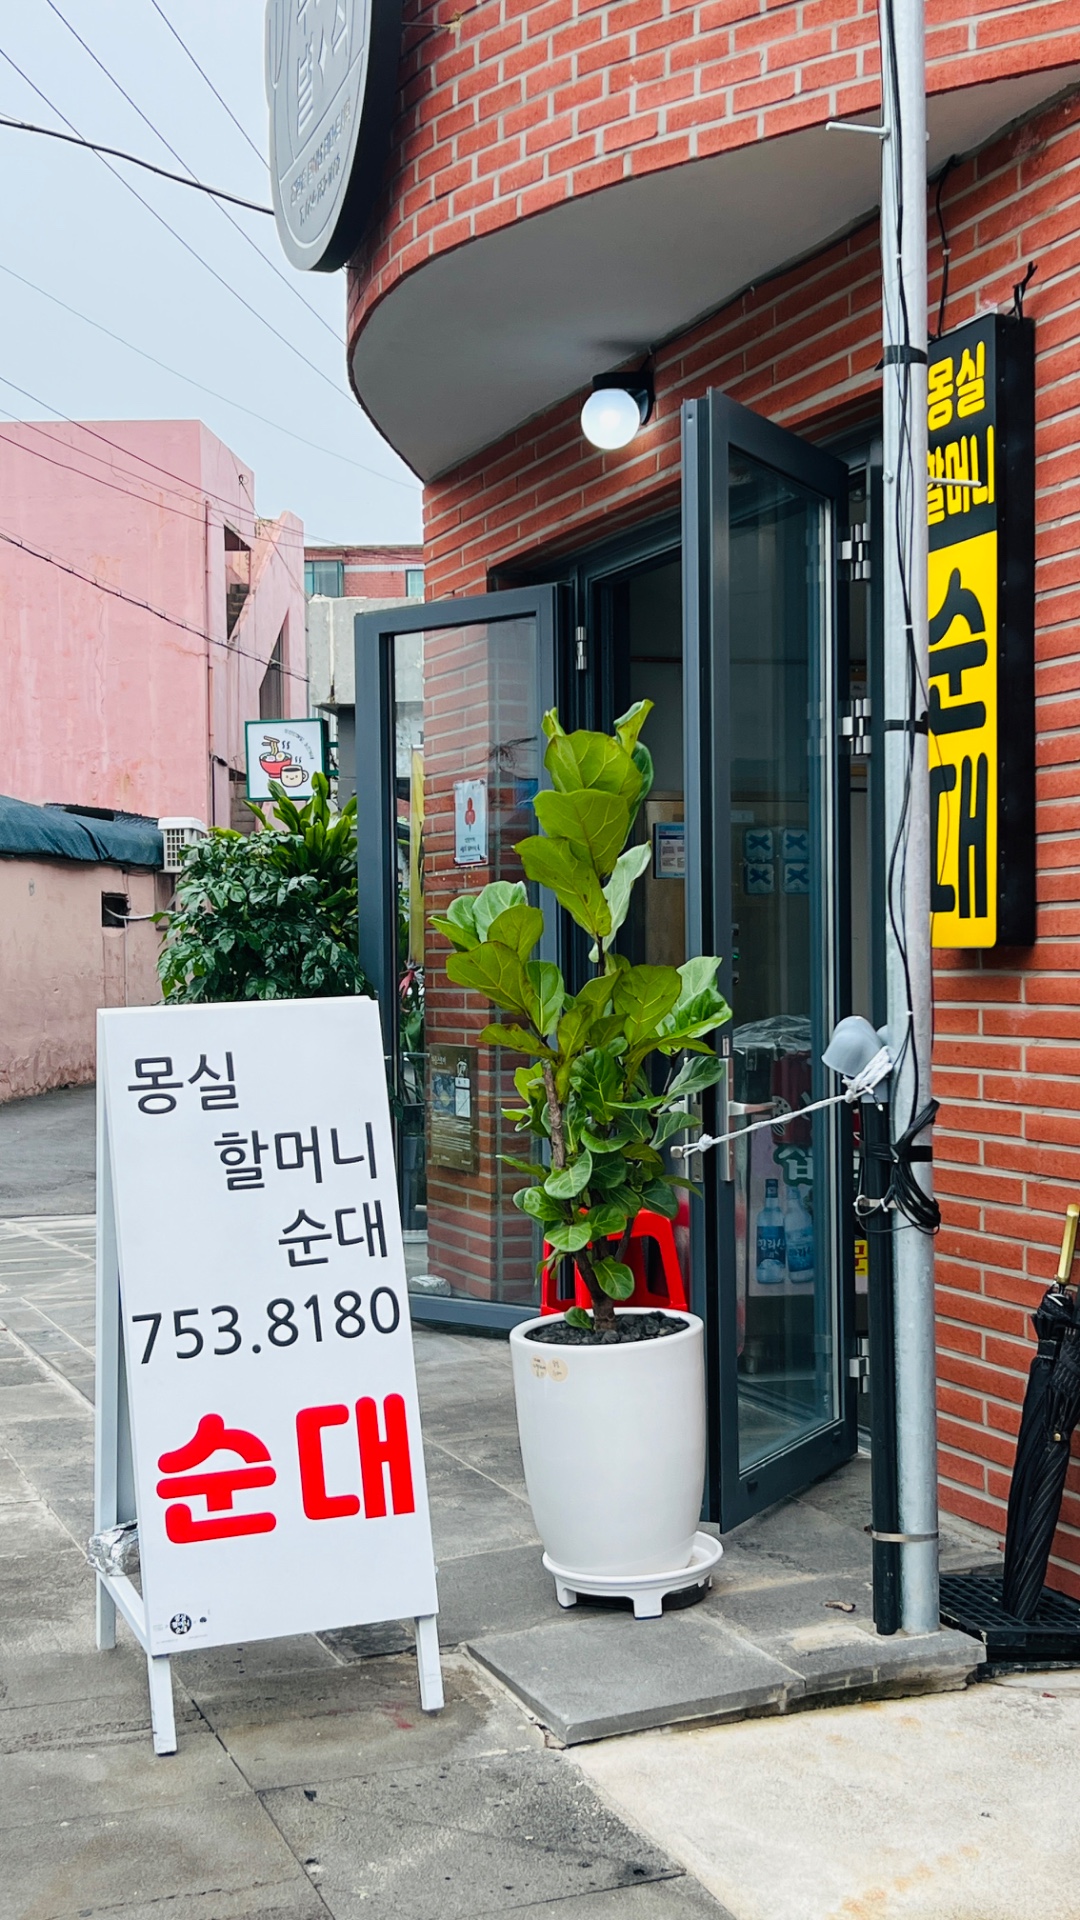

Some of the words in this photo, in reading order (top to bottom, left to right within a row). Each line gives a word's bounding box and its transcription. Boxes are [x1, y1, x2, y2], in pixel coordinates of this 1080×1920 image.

[927, 341, 986, 431] 몽실
[928, 567, 988, 919] 순대
[127, 1051, 239, 1115] 몽실
[213, 1121, 378, 1191] 할머니
[278, 1199, 388, 1267] 순대
[131, 1286, 400, 1364] 753.8180
[156, 1393, 416, 1544] 순대
